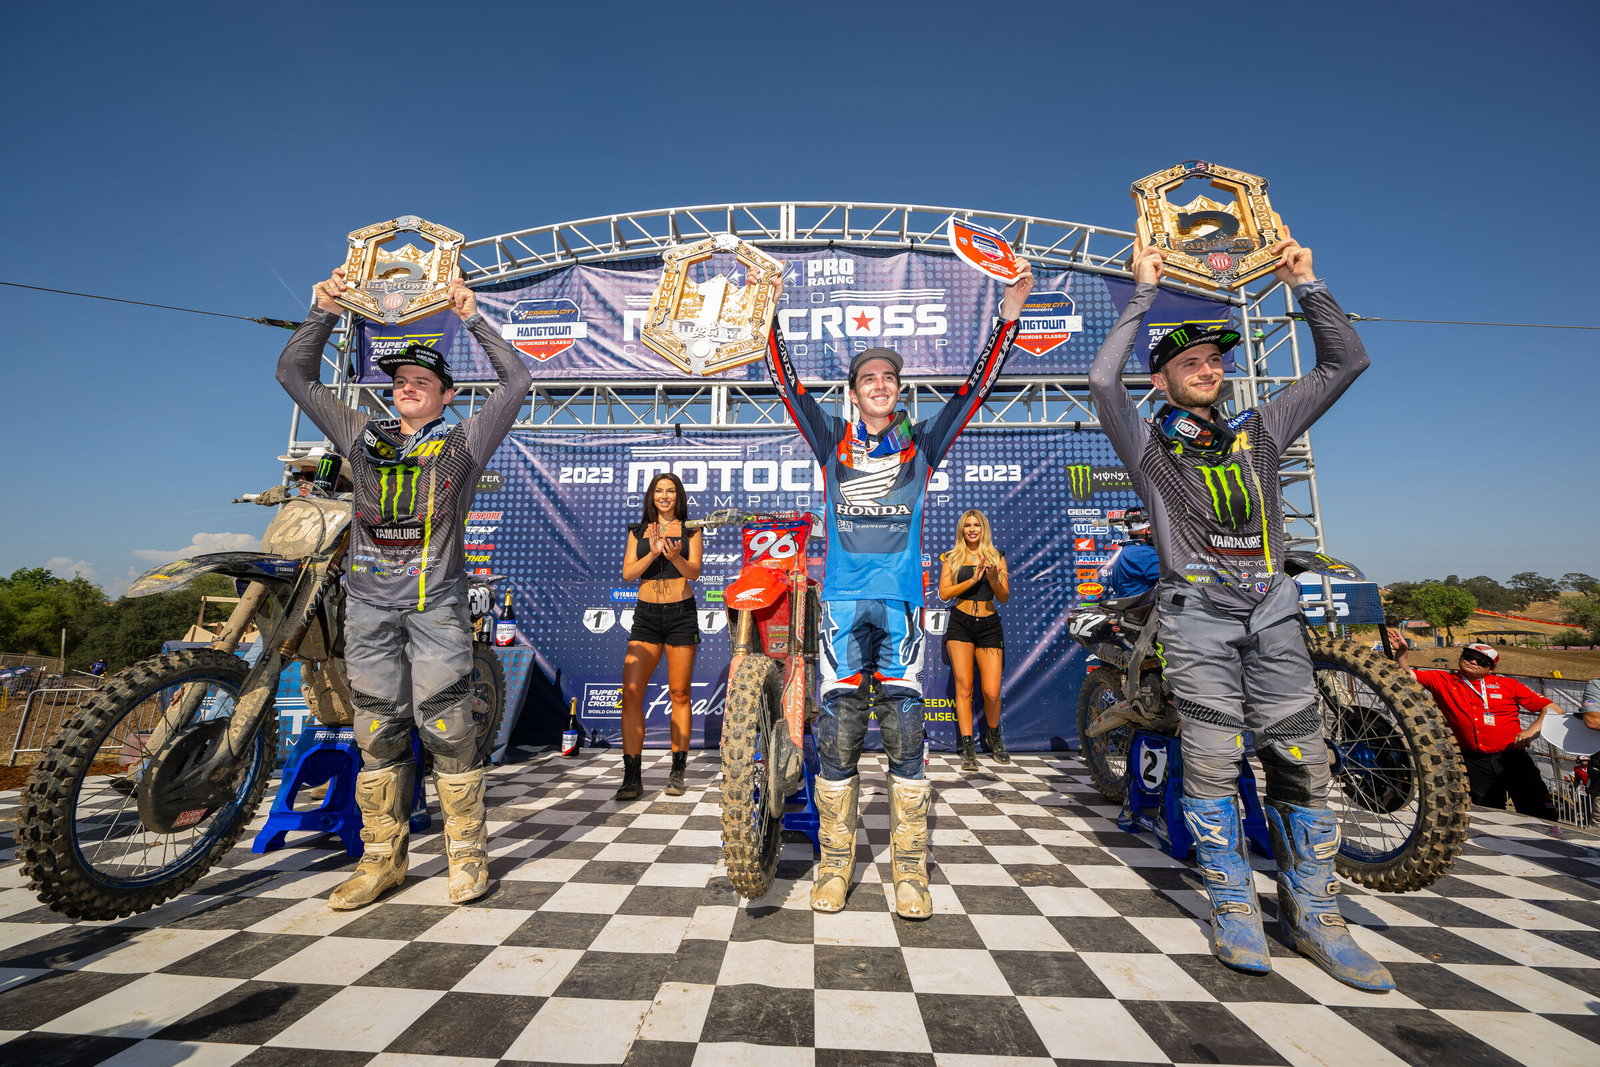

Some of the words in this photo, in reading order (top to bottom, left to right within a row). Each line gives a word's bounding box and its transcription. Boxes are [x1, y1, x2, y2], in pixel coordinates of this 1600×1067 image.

[808, 259, 854, 277] PRO
[808, 276, 854, 287] RACING
[516, 326, 572, 337] HANGTOWN
[1019, 319, 1066, 330] ANGTOWN
[777, 328, 796, 388] HONDA
[968, 324, 1001, 387] HONDA
[1178, 421, 1198, 436] 100%
[559, 467, 613, 483] 2023
[965, 464, 1021, 482] 2023
[836, 503, 911, 516] HONDA
[1067, 508, 1101, 516] GEICO
[373, 528, 421, 540] YAMALUBE
[1210, 534, 1262, 549] YAMALUBE
[749, 530, 799, 562] 96
[1069, 613, 1107, 638] 32
[924, 698, 956, 708] EEDW
[1143, 750, 1158, 784] 2
